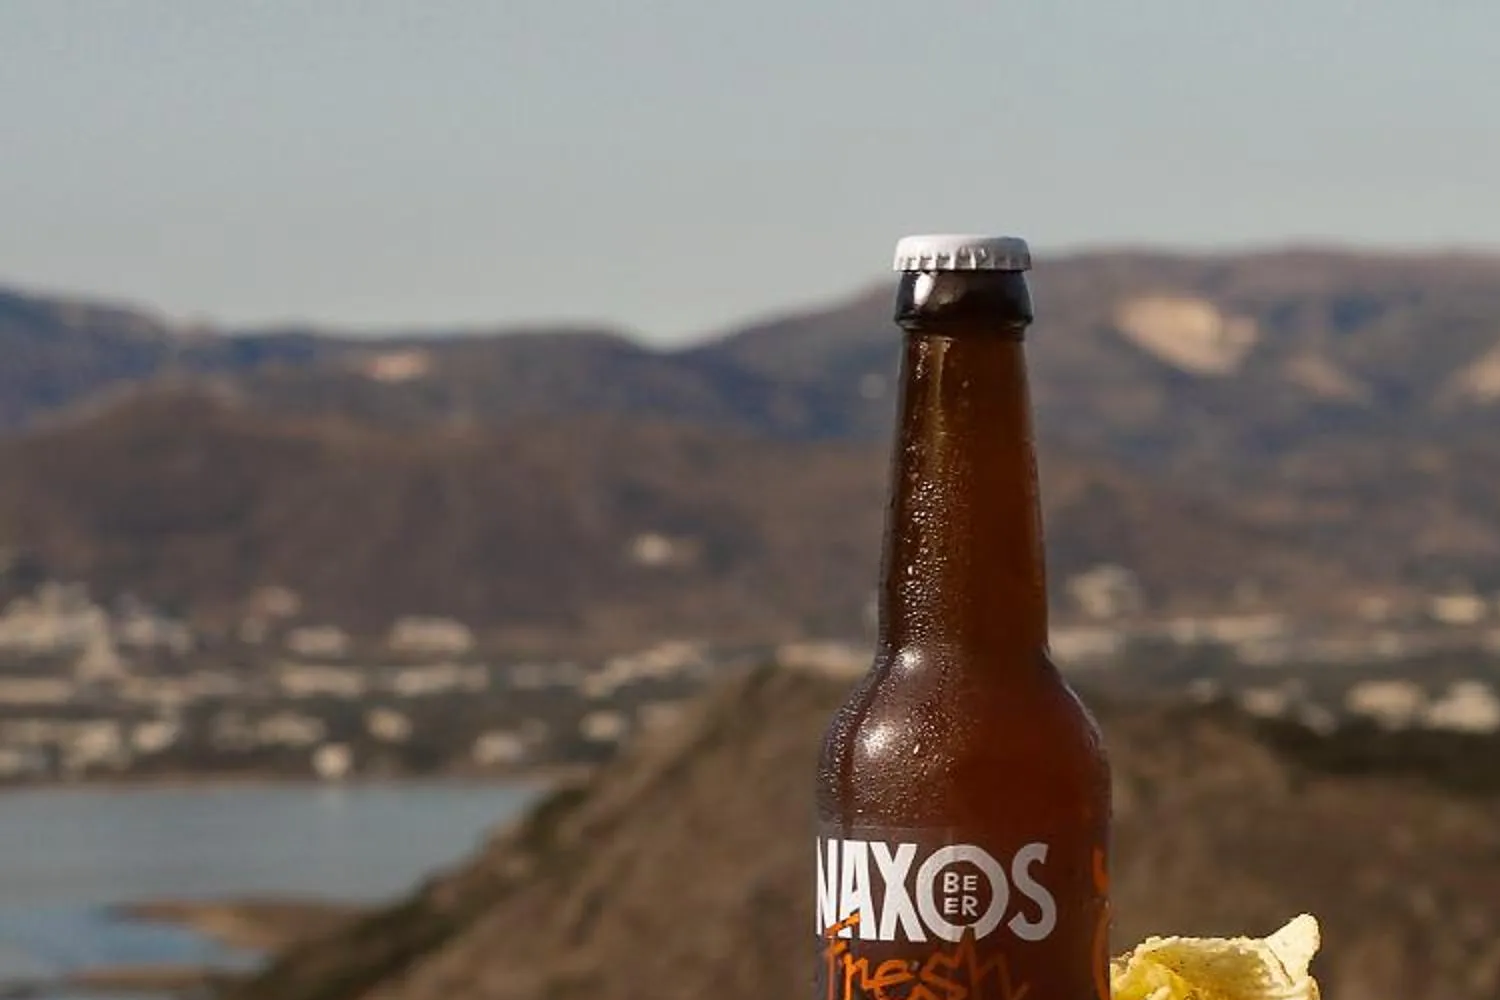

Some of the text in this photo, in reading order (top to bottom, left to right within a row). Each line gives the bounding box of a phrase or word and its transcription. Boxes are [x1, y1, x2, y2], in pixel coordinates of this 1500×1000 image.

[817, 836, 1057, 943] NAXOS
[943, 872, 978, 894] BE
[943, 896, 978, 917] ER
